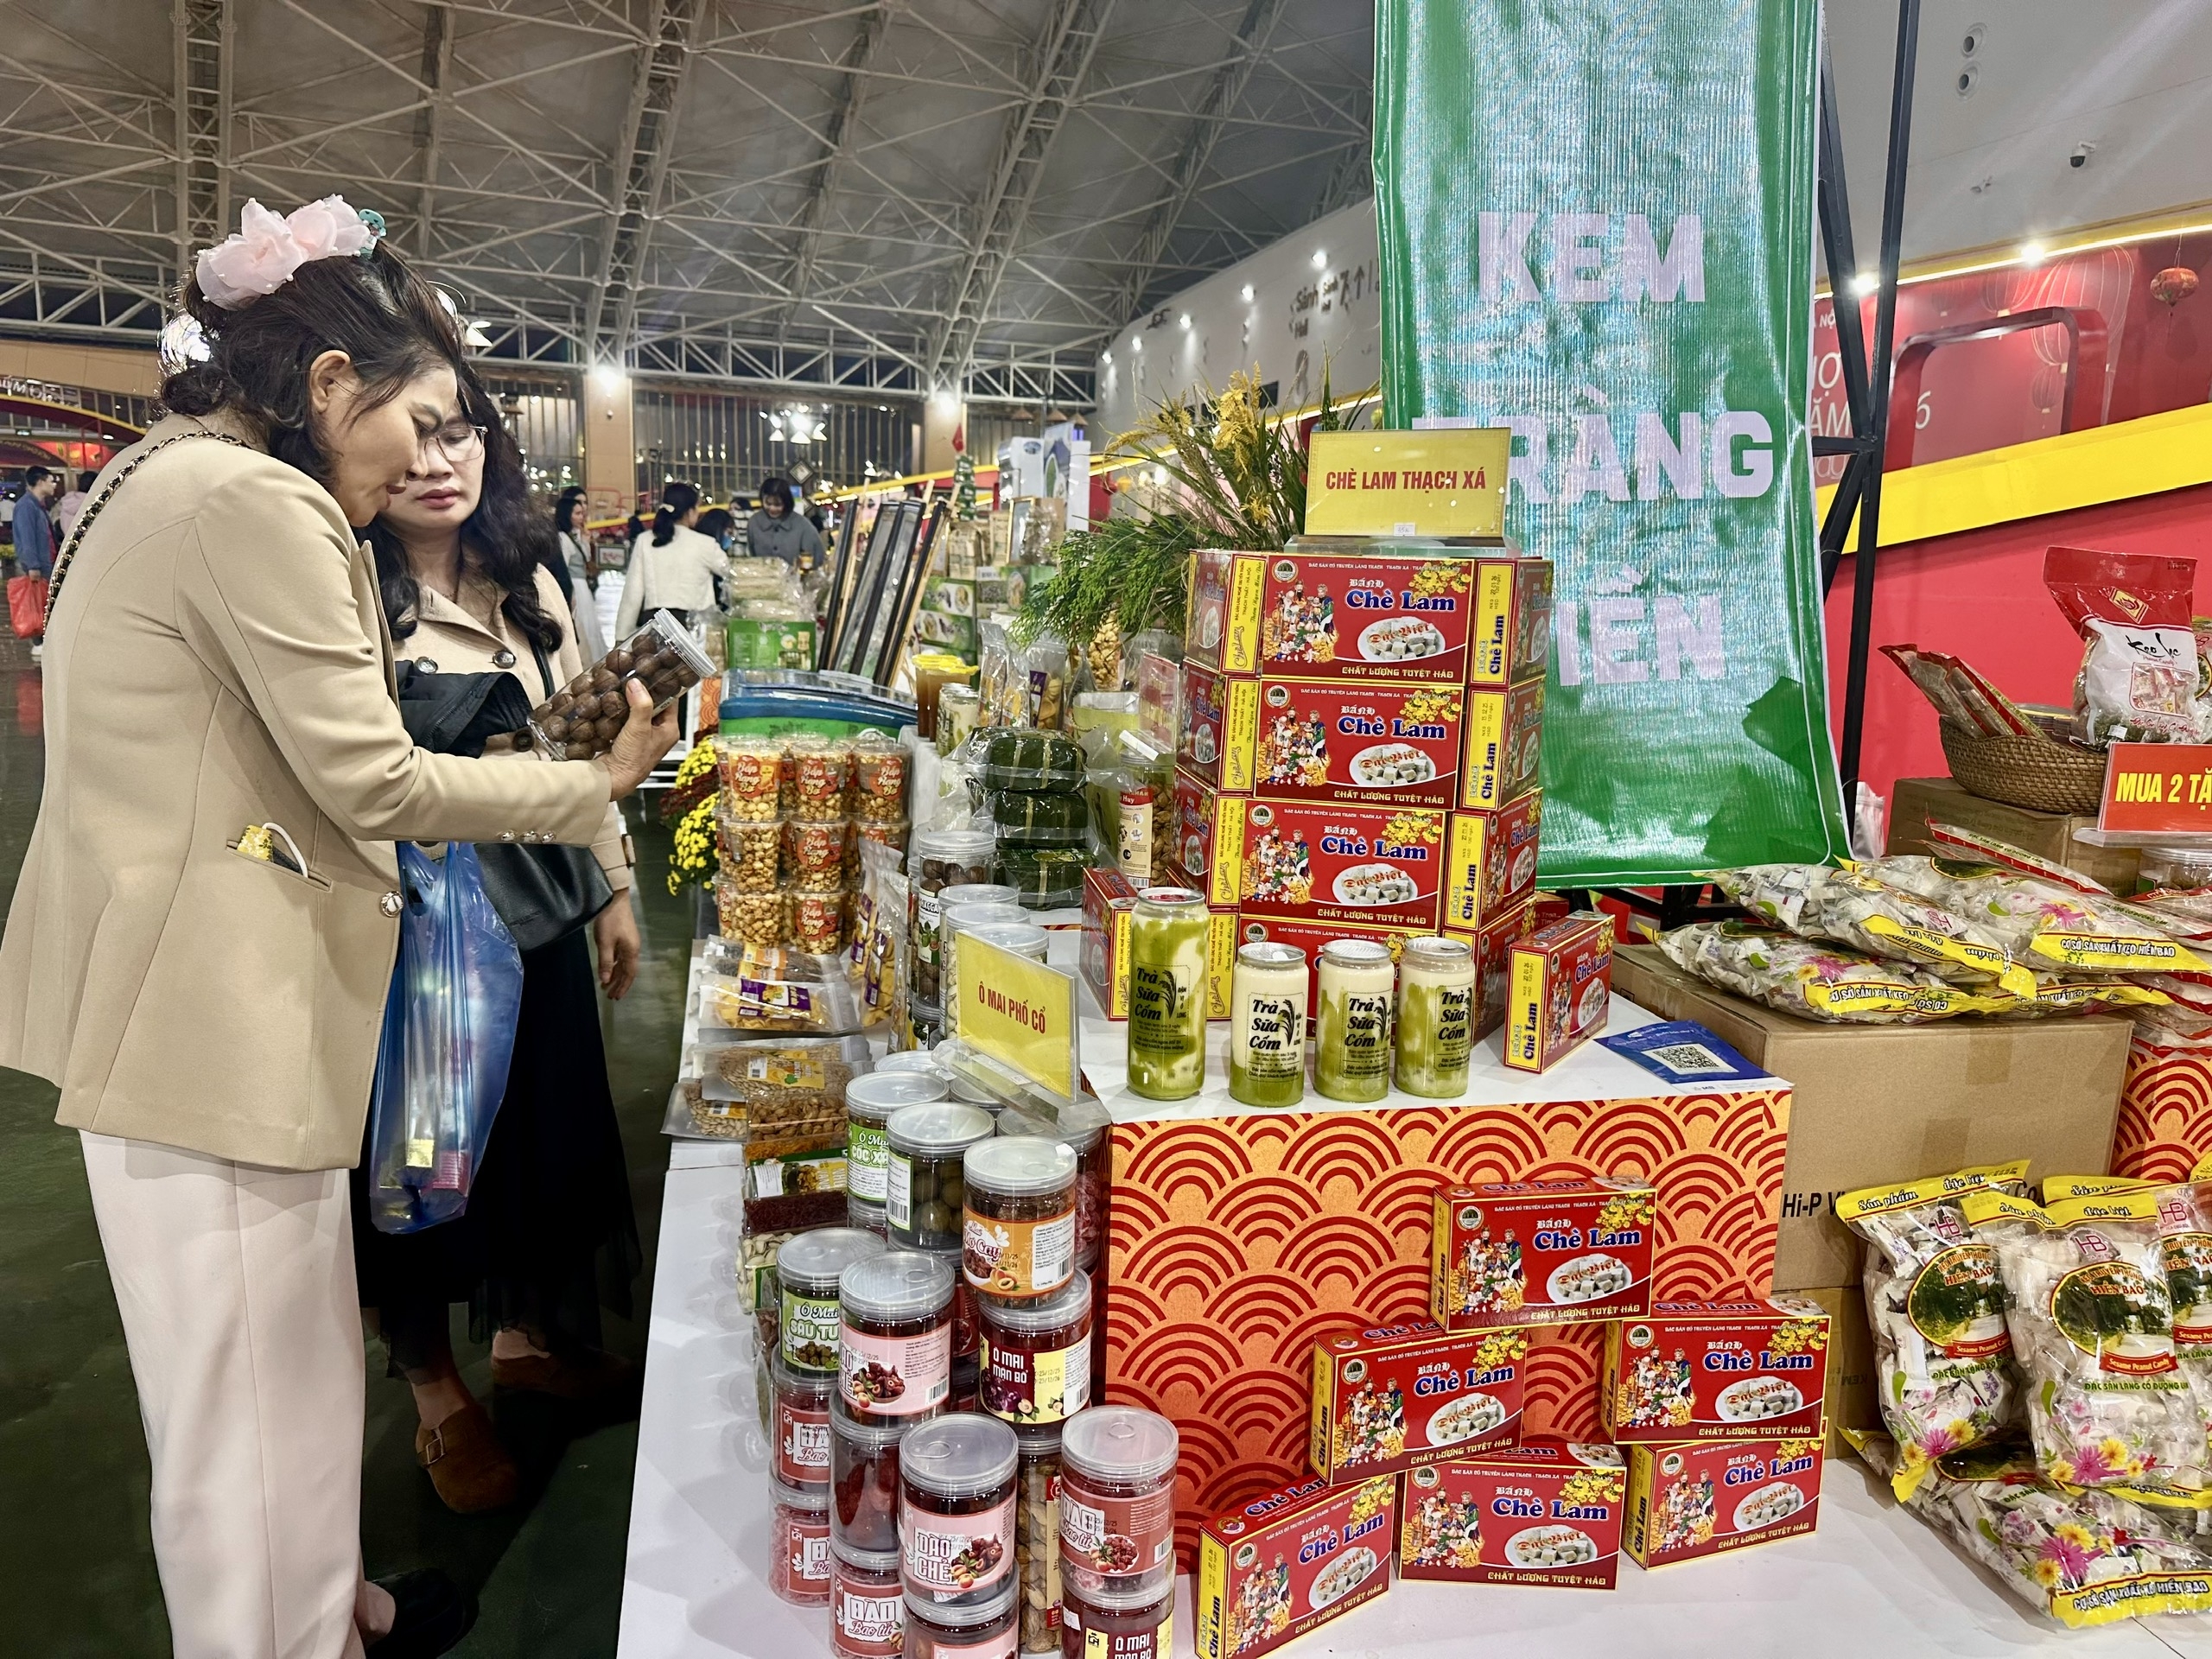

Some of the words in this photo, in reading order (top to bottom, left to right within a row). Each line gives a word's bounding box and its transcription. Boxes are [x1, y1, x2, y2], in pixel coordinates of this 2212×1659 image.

[1478, 211, 1706, 302] KEM
[1820, 312, 1835, 329] NỘ
[1412, 384, 1773, 504] RÀNG
[1325, 466, 1357, 490] CHÈ
[1363, 472, 1395, 490] LAM
[1402, 471, 1457, 494] THẠCH
[1463, 466, 1486, 490] XÁ
[1347, 588, 1394, 610] Chè
[1402, 592, 1454, 612] Lam
[1491, 615, 1504, 645] Lam
[1555, 564, 1726, 687] IỀN
[1342, 664, 1366, 675] CHẤT
[1369, 666, 1399, 677] LƯỢNG
[1402, 667, 1431, 677] TUYỆT
[1433, 670, 1453, 679] HẢO
[1338, 715, 1384, 736] Chè
[1392, 719, 1445, 740] Lam
[2115, 772, 2162, 802] MUA
[2168, 775, 2183, 803] 2
[1321, 835, 1367, 856] Chè
[1375, 840, 1427, 861] Lam
[1317, 906, 1341, 918] CHẤT
[1344, 909, 1373, 921] LƯỢNG
[1376, 912, 1404, 923] TUYỆT
[1406, 915, 1426, 925] HẢO
[2158, 946, 2175, 957] BAO
[1137, 967, 1158, 983] Trà
[1136, 986, 1160, 1001] Sữa
[1440, 990, 1464, 1004] Trà
[978, 981, 984, 1003] Ô
[988, 990, 1006, 1012] MAI
[1009, 1001, 1028, 1026] PHỐ
[1031, 1006, 1046, 1034] CỔ
[1135, 1004, 1161, 1020] Cốm
[1253, 999, 1277, 1014] Trà
[1349, 997, 1373, 1013] Trà
[1251, 1016, 1280, 1033] Sữa
[1347, 1016, 1375, 1030] Sữa
[1440, 1008, 1465, 1023] Sữa
[1249, 1034, 1281, 1050] Cốm
[1344, 1033, 1376, 1047] Cốm
[1438, 1027, 1465, 1040] Cốm
[859, 1131, 867, 1143] Ô
[868, 1134, 888, 1146] Ma
[1783, 1191, 1822, 1218] Hi-P
[1884, 1189, 1918, 1208] phẩm
[1535, 1229, 1581, 1250] Chè
[1588, 1227, 1640, 1247] Lam
[976, 1239, 1002, 1262] Cay
[800, 1301, 810, 1316] Ô
[812, 1306, 839, 1319] Mai
[1531, 1308, 1555, 1319] CHẤT
[1558, 1307, 1588, 1319] LƯỢNG
[1591, 1305, 1618, 1314] TUYỆT
[790, 1319, 817, 1339] SẤU
[2178, 1331, 2202, 1339] Sesame
[1979, 1341, 1998, 1351] Peanut
[993, 1346, 999, 1362] Ô
[1002, 1351, 1024, 1369] MAI
[1705, 1351, 1751, 1370] Chè
[1760, 1352, 1812, 1369] Lam
[2108, 1358, 2132, 1370] Sesame
[2153, 1358, 2170, 1369] Candy
[1415, 1370, 1459, 1396] Chè
[1465, 1363, 1513, 1387] Lam
[1699, 1427, 1724, 1435] CHẤT
[1726, 1427, 1757, 1436] LƯỢNG
[1725, 1461, 1764, 1486] Chè
[1770, 1453, 1813, 1477] Lam
[1493, 1496, 1542, 1517] Chè
[1551, 1500, 1607, 1521] Lam
[918, 1532, 951, 1557] ĐÀO
[1300, 1531, 1338, 1564] Chè
[1344, 1513, 1384, 1544] Lam
[1488, 1570, 1514, 1580] CHẤT
[1516, 1572, 1548, 1584] LƯỢNG
[1552, 1573, 1582, 1584] TUYỆT
[1585, 1577, 1605, 1586] HẢO
[849, 1597, 896, 1622] ĐÀO
[849, 1622, 876, 1637] Bao
[1116, 1636, 1124, 1651] Ô
[1127, 1633, 1150, 1648] MAI
